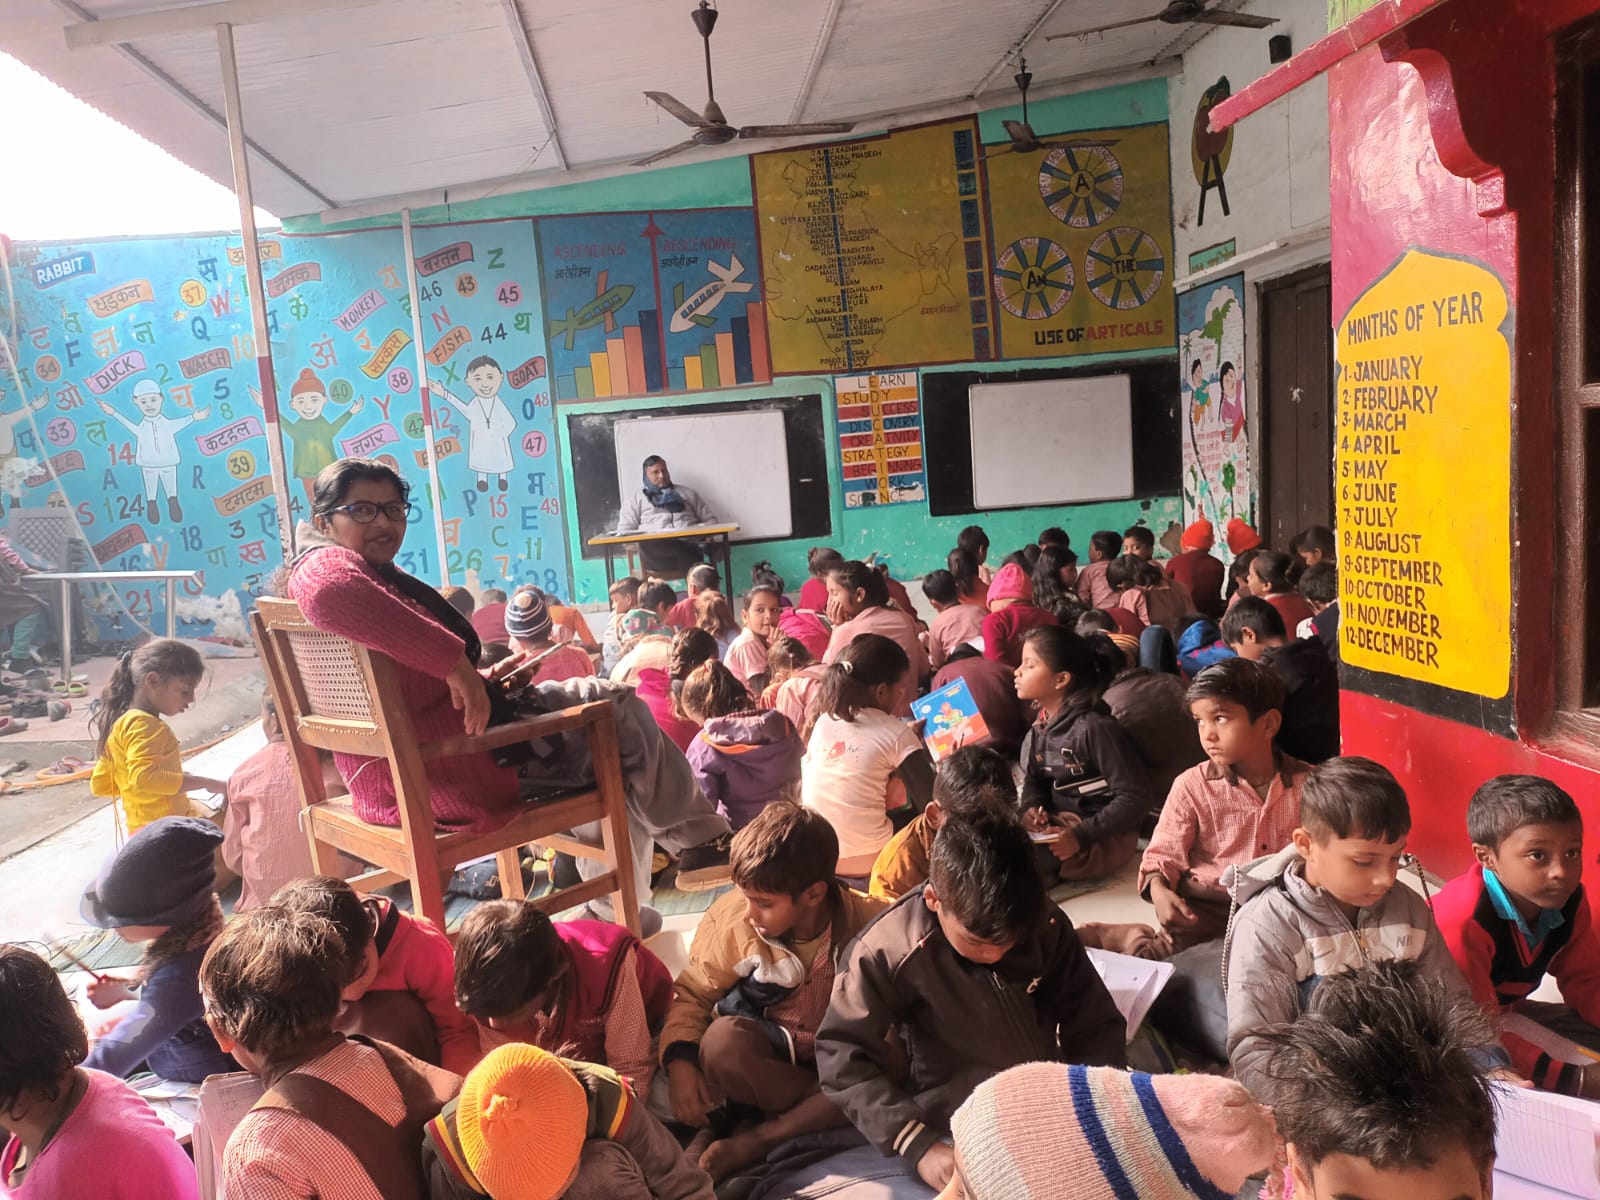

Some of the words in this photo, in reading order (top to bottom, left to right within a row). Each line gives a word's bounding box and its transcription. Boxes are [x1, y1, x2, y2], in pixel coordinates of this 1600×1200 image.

[1075, 174, 1090, 193] A
[36, 256, 84, 284] RABBIT
[422, 247, 460, 272] बरतन
[488, 247, 505, 270] Z
[1113, 259, 1135, 274] THE
[276, 268, 309, 293] नमक
[420, 280, 442, 302] 46
[457, 276, 474, 293] 43
[182, 287, 201, 304] 37
[210, 290, 230, 318] W
[498, 285, 519, 304] 45
[340, 292, 376, 329] MONKEY
[431, 305, 451, 333] N
[1348, 309, 1398, 345] MONTHS
[1405, 303, 1425, 332] OF
[1432, 292, 1483, 327] YEAR
[192, 316, 210, 341] Q
[480, 323, 507, 344] 44
[1034, 329, 1063, 345] USE
[1066, 327, 1084, 343] OF
[65, 340, 81, 367] F
[233, 336, 255, 360] 10
[433, 330, 464, 362] FISH
[38, 360, 56, 378] 34
[96, 356, 135, 390] DUCK
[155, 363, 173, 385] 2
[184, 351, 227, 376] WATCH
[441, 361, 459, 385] X
[512, 360, 539, 386] GOAT
[214, 377, 230, 400] 5
[391, 371, 408, 388] 38
[857, 374, 906, 389] LEARN
[332, 384, 348, 399] 40
[534, 392, 549, 407] 48
[842, 390, 890, 405] STUDY
[220, 402, 234, 420] 8
[372, 394, 390, 420] Y
[432, 407, 454, 430] 12
[861, 401, 917, 418] SUCCESS
[48, 421, 70, 442] 33
[204, 421, 251, 451] कटहल
[850, 416, 918, 433] DISCOVERY
[350, 428, 385, 454] नगर
[525, 437, 542, 451] 47
[850, 429, 919, 447] CREATIVITY
[108, 441, 135, 465] 14
[421, 440, 452, 466] BRD
[843, 446, 909, 463] STRATEGY
[230, 455, 250, 475] 39
[853, 462, 922, 478] BEGINNING
[102, 469, 118, 490] A
[192, 465, 205, 489] R
[865, 475, 905, 490] WORK
[116, 494, 144, 520] 24
[222, 481, 265, 511] टमटम
[463, 489, 477, 517] P
[489, 493, 508, 518] 15
[540, 498, 559, 516] 49
[78, 502, 95, 526] S
[521, 506, 538, 530] E
[180, 525, 202, 552] 18
[229, 520, 245, 538] 3
[492, 526, 509, 547] C
[239, 540, 266, 564] ख
[525, 537, 541, 560] 11
[447, 549, 482, 574] 26
[126, 589, 152, 614] 21
